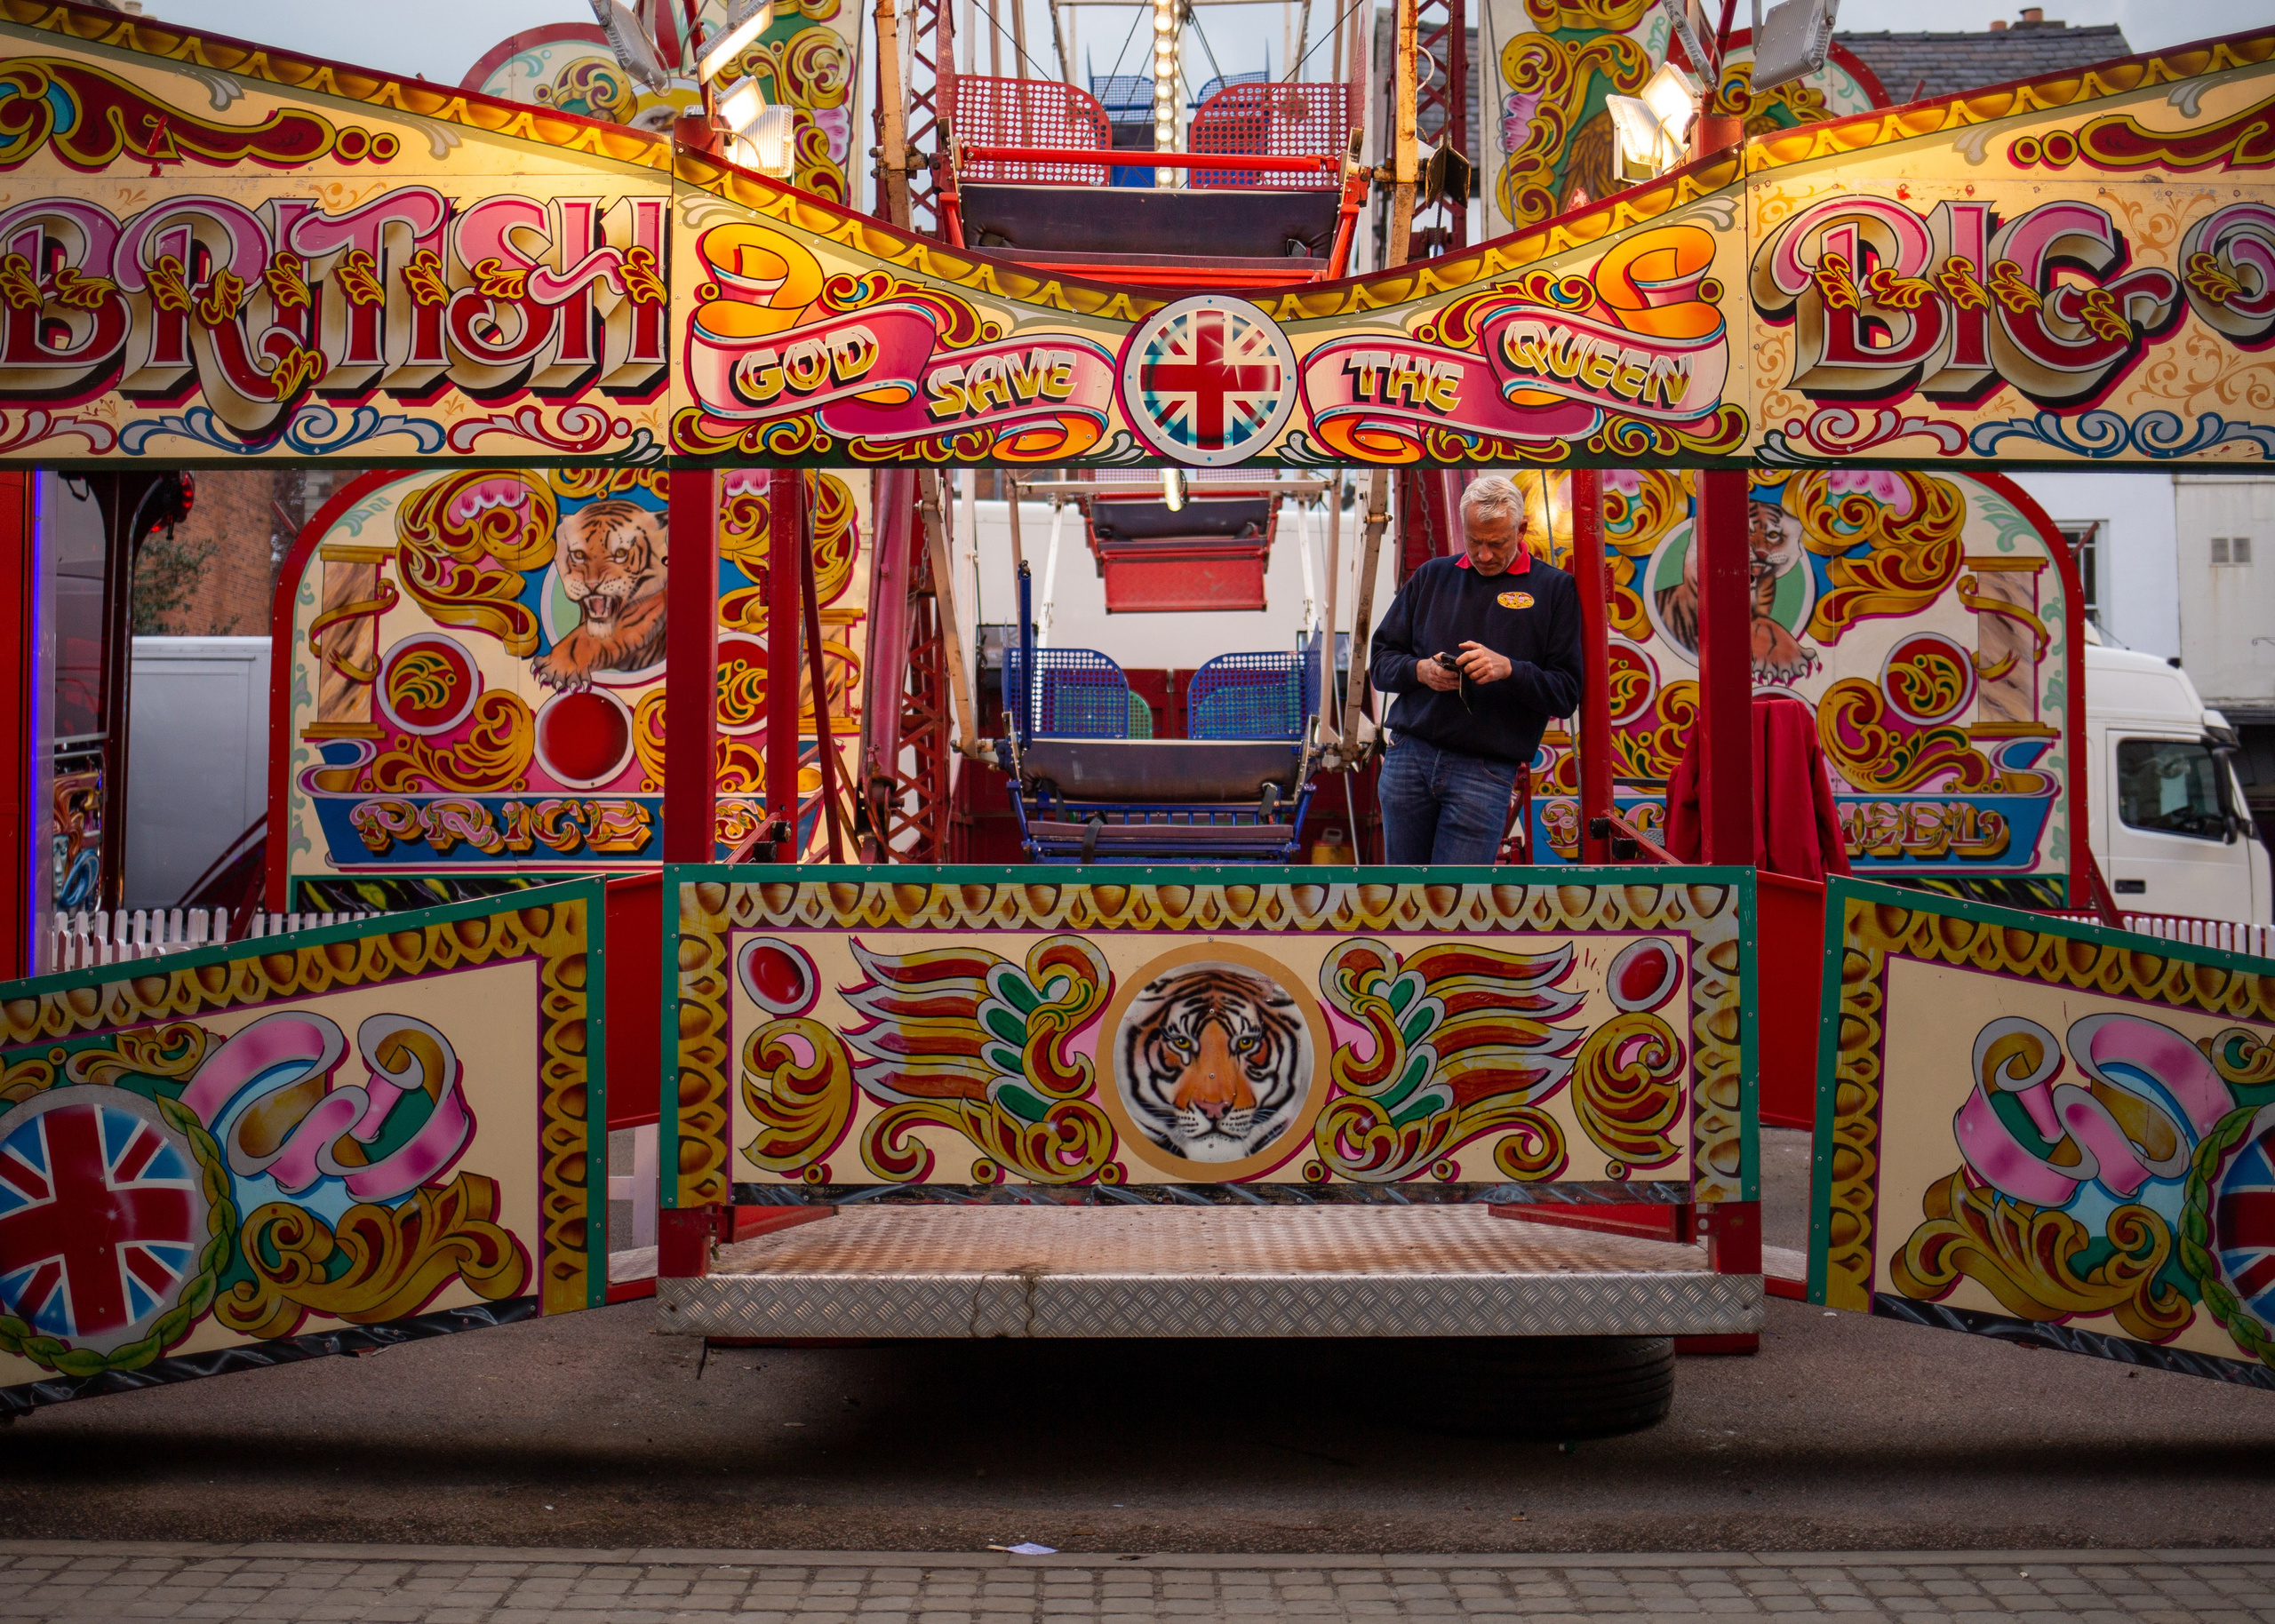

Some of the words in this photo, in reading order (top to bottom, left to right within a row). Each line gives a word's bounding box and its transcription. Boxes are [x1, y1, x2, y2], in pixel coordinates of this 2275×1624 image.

[0, 186, 673, 437] BRITISH
[730, 325, 878, 405] GOD
[924, 345, 1078, 420] SAVE
[1342, 349, 1465, 414] THE
[1502, 320, 1694, 409] QUEEN
[1751, 194, 2186, 410] BIG
